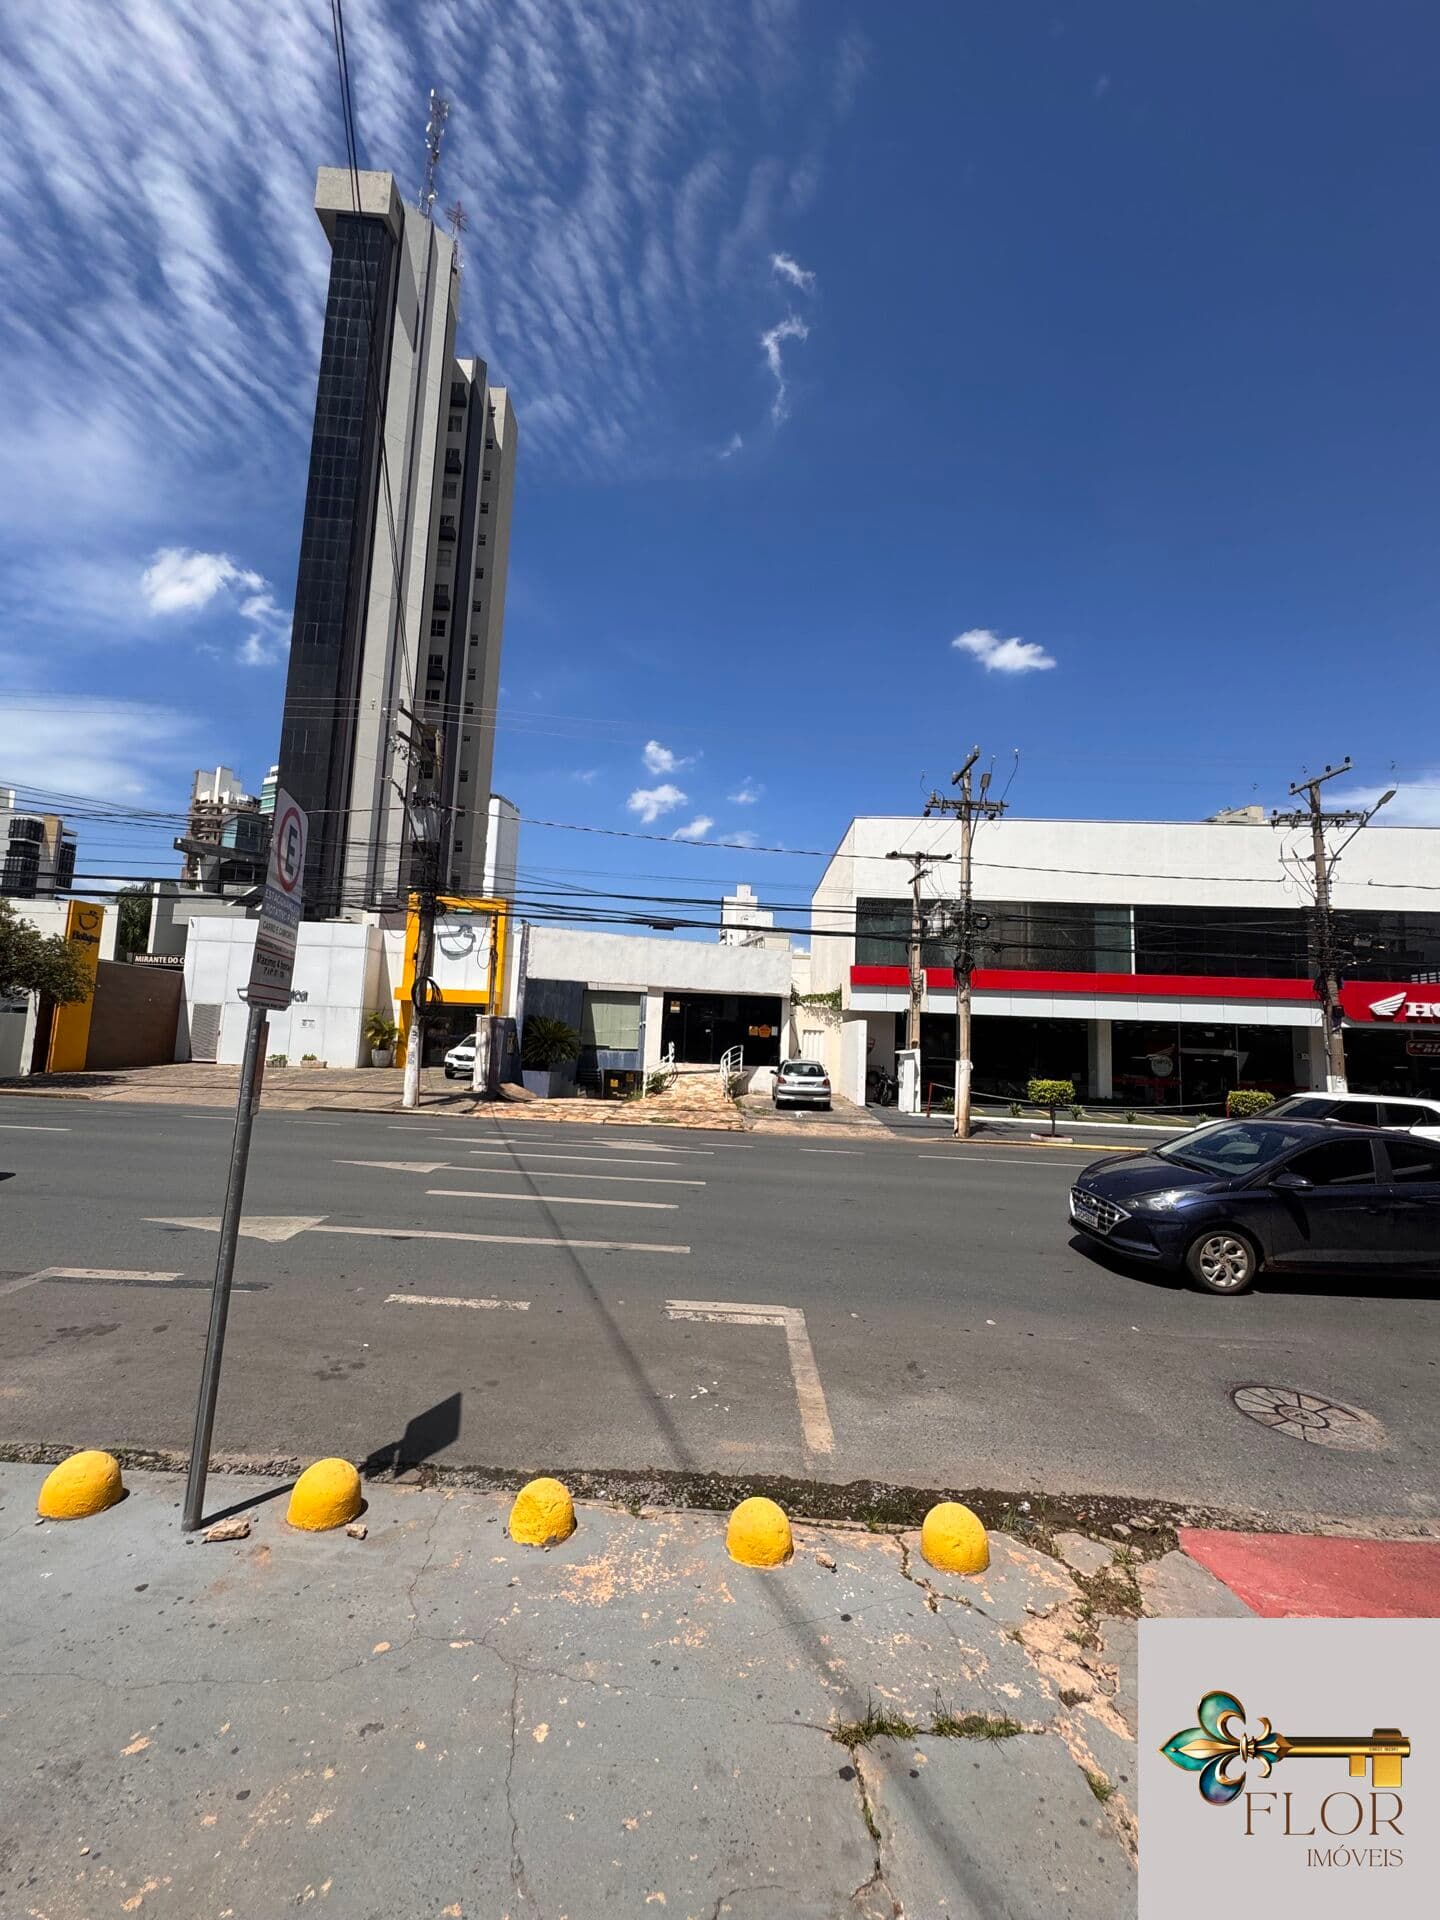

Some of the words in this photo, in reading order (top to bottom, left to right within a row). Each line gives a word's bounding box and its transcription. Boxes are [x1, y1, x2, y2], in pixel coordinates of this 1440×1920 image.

[286, 825, 297, 875] E
[135, 955, 168, 963] MIRANTE
[168, 956, 178, 964] DO
